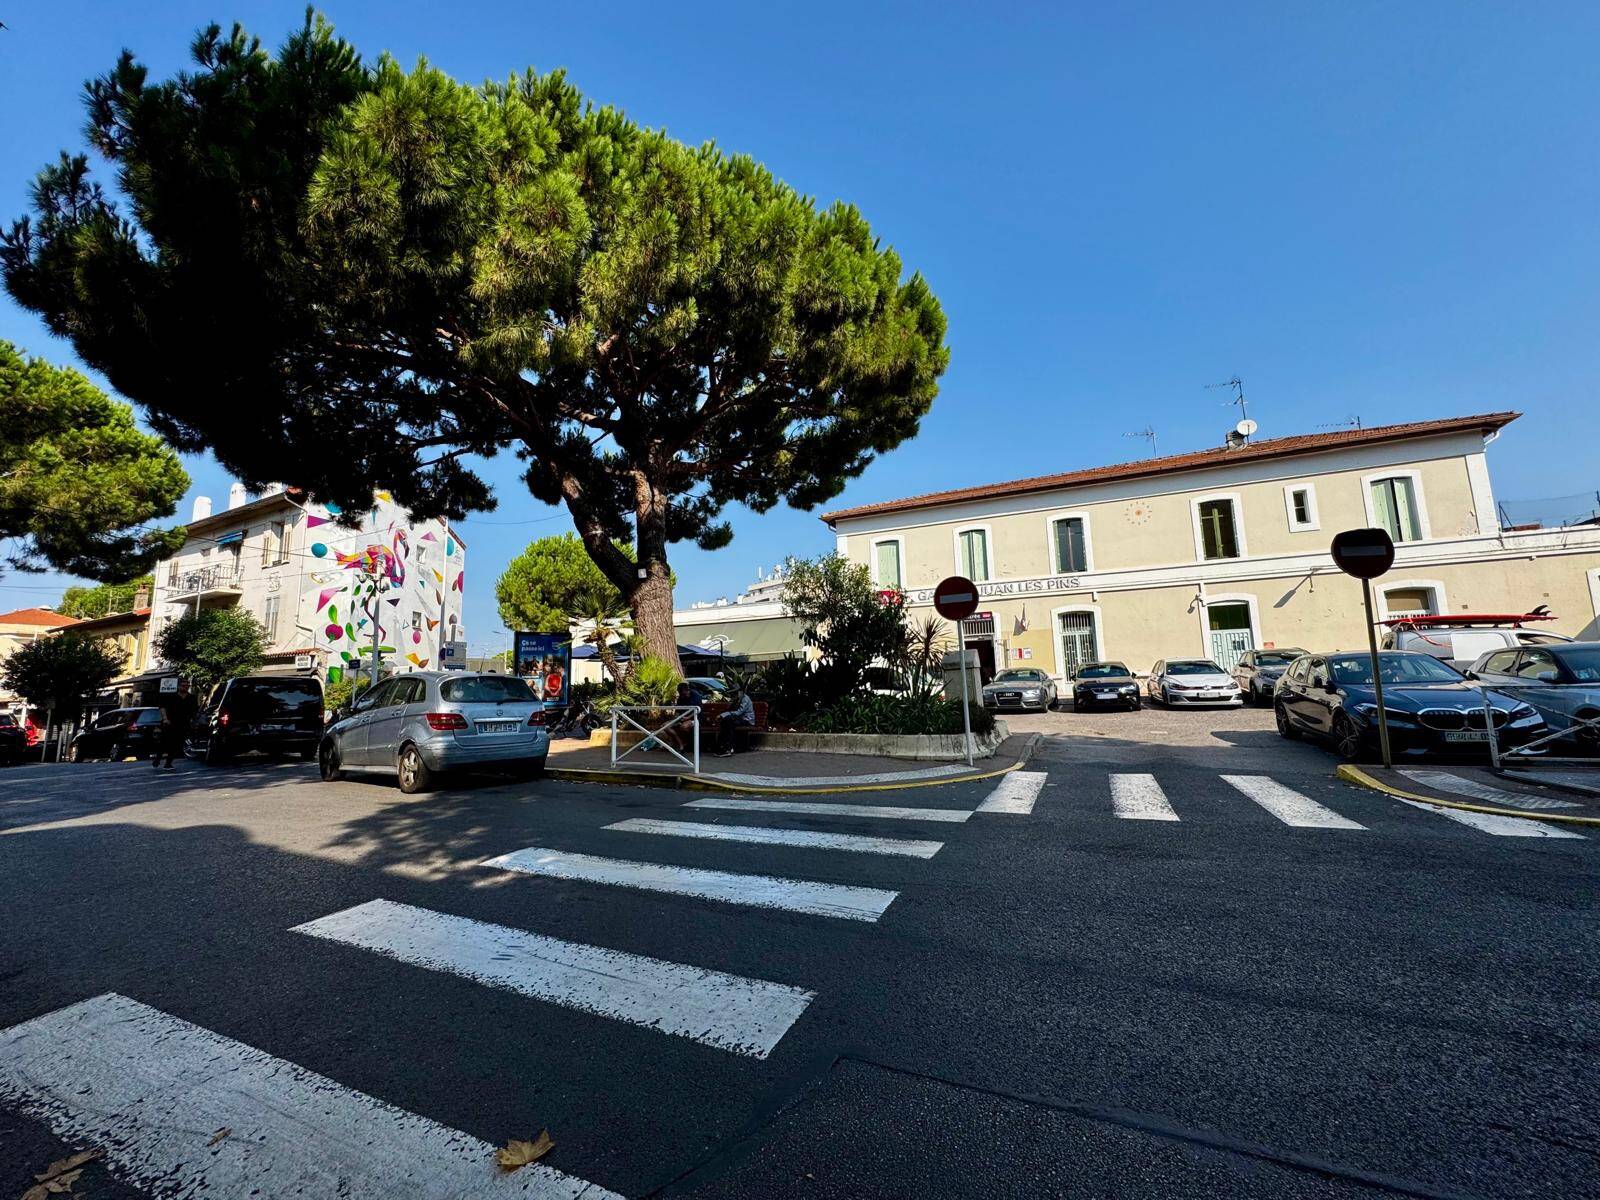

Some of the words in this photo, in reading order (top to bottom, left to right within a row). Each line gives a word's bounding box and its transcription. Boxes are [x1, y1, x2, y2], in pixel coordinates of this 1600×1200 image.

[980, 584, 1013, 597] JUAN
[1018, 581, 1043, 592] LES
[1047, 577, 1080, 590] PINS
